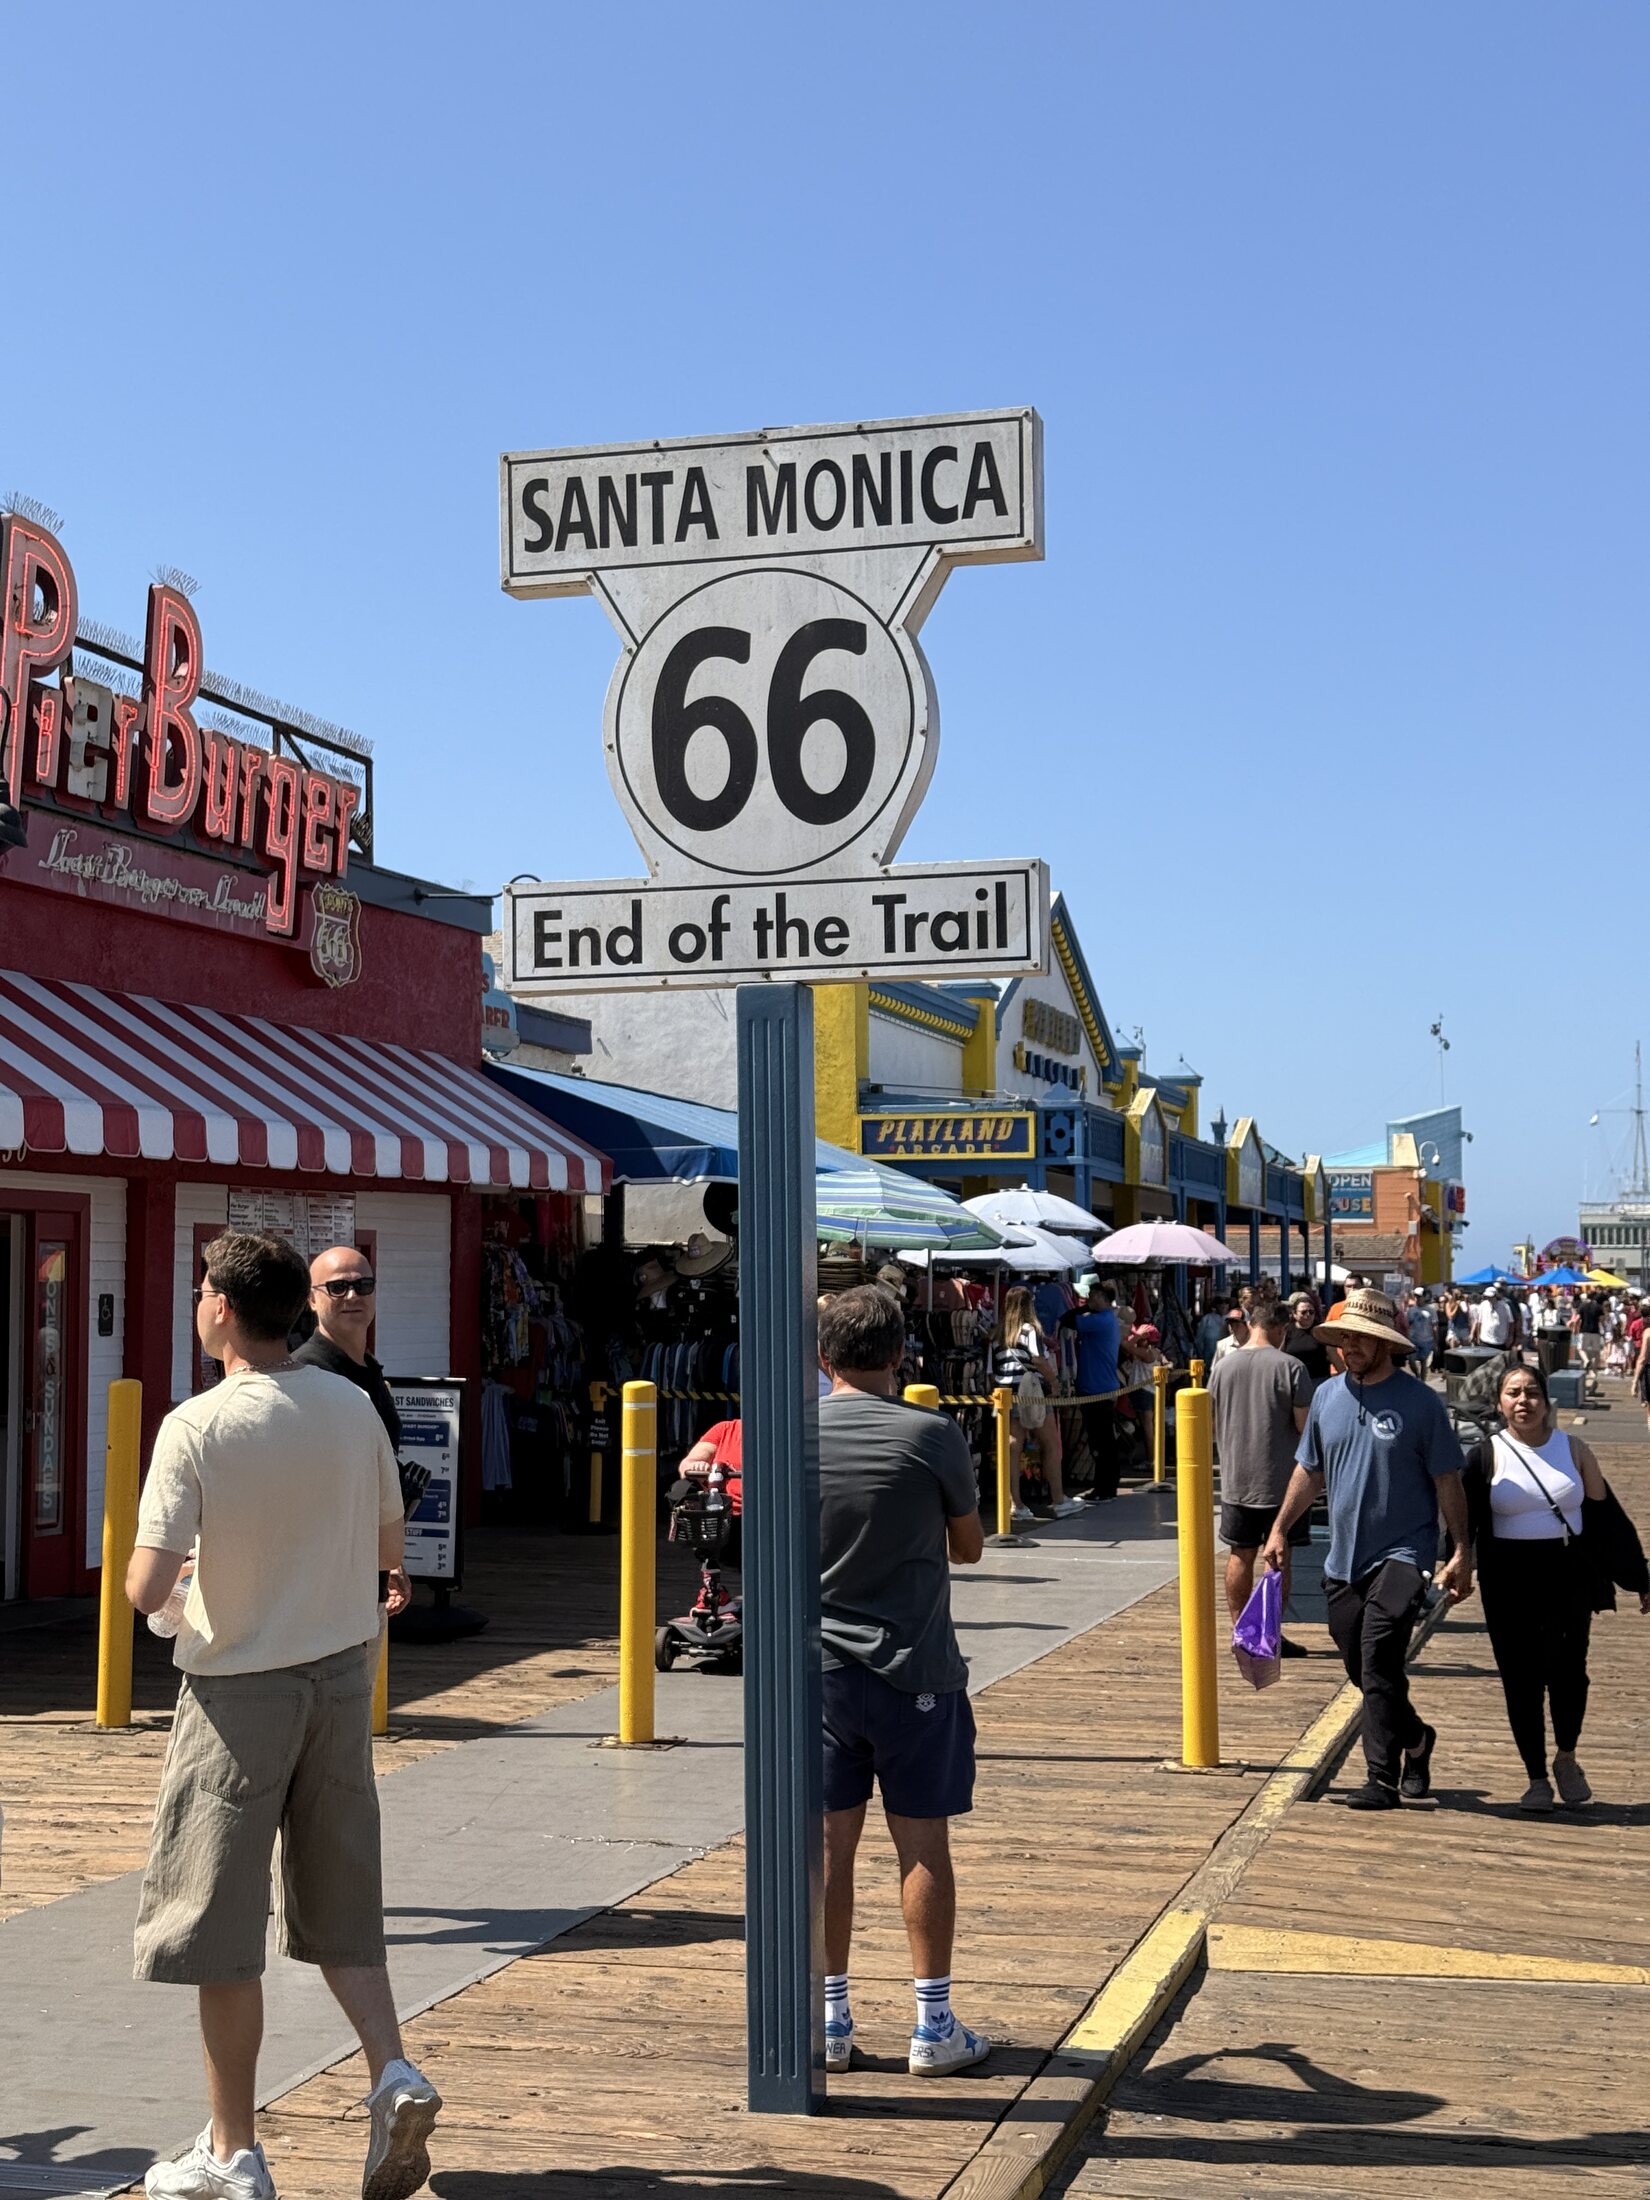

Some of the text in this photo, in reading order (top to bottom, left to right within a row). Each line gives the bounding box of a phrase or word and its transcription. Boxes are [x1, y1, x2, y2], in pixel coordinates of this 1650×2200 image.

[522, 441, 1009, 553] SANTA MONICA
[652, 618, 876, 832] 66
[534, 881, 1008, 968] End of the Trail
[877, 1118, 1014, 1142] PLAYLAND
[896, 1143, 993, 1154] ARCADE
[1328, 1173, 1372, 1187] OPEN
[406, 1396, 454, 1408] SANDWICHES
[44, 1382, 57, 1509] SUNDAES
